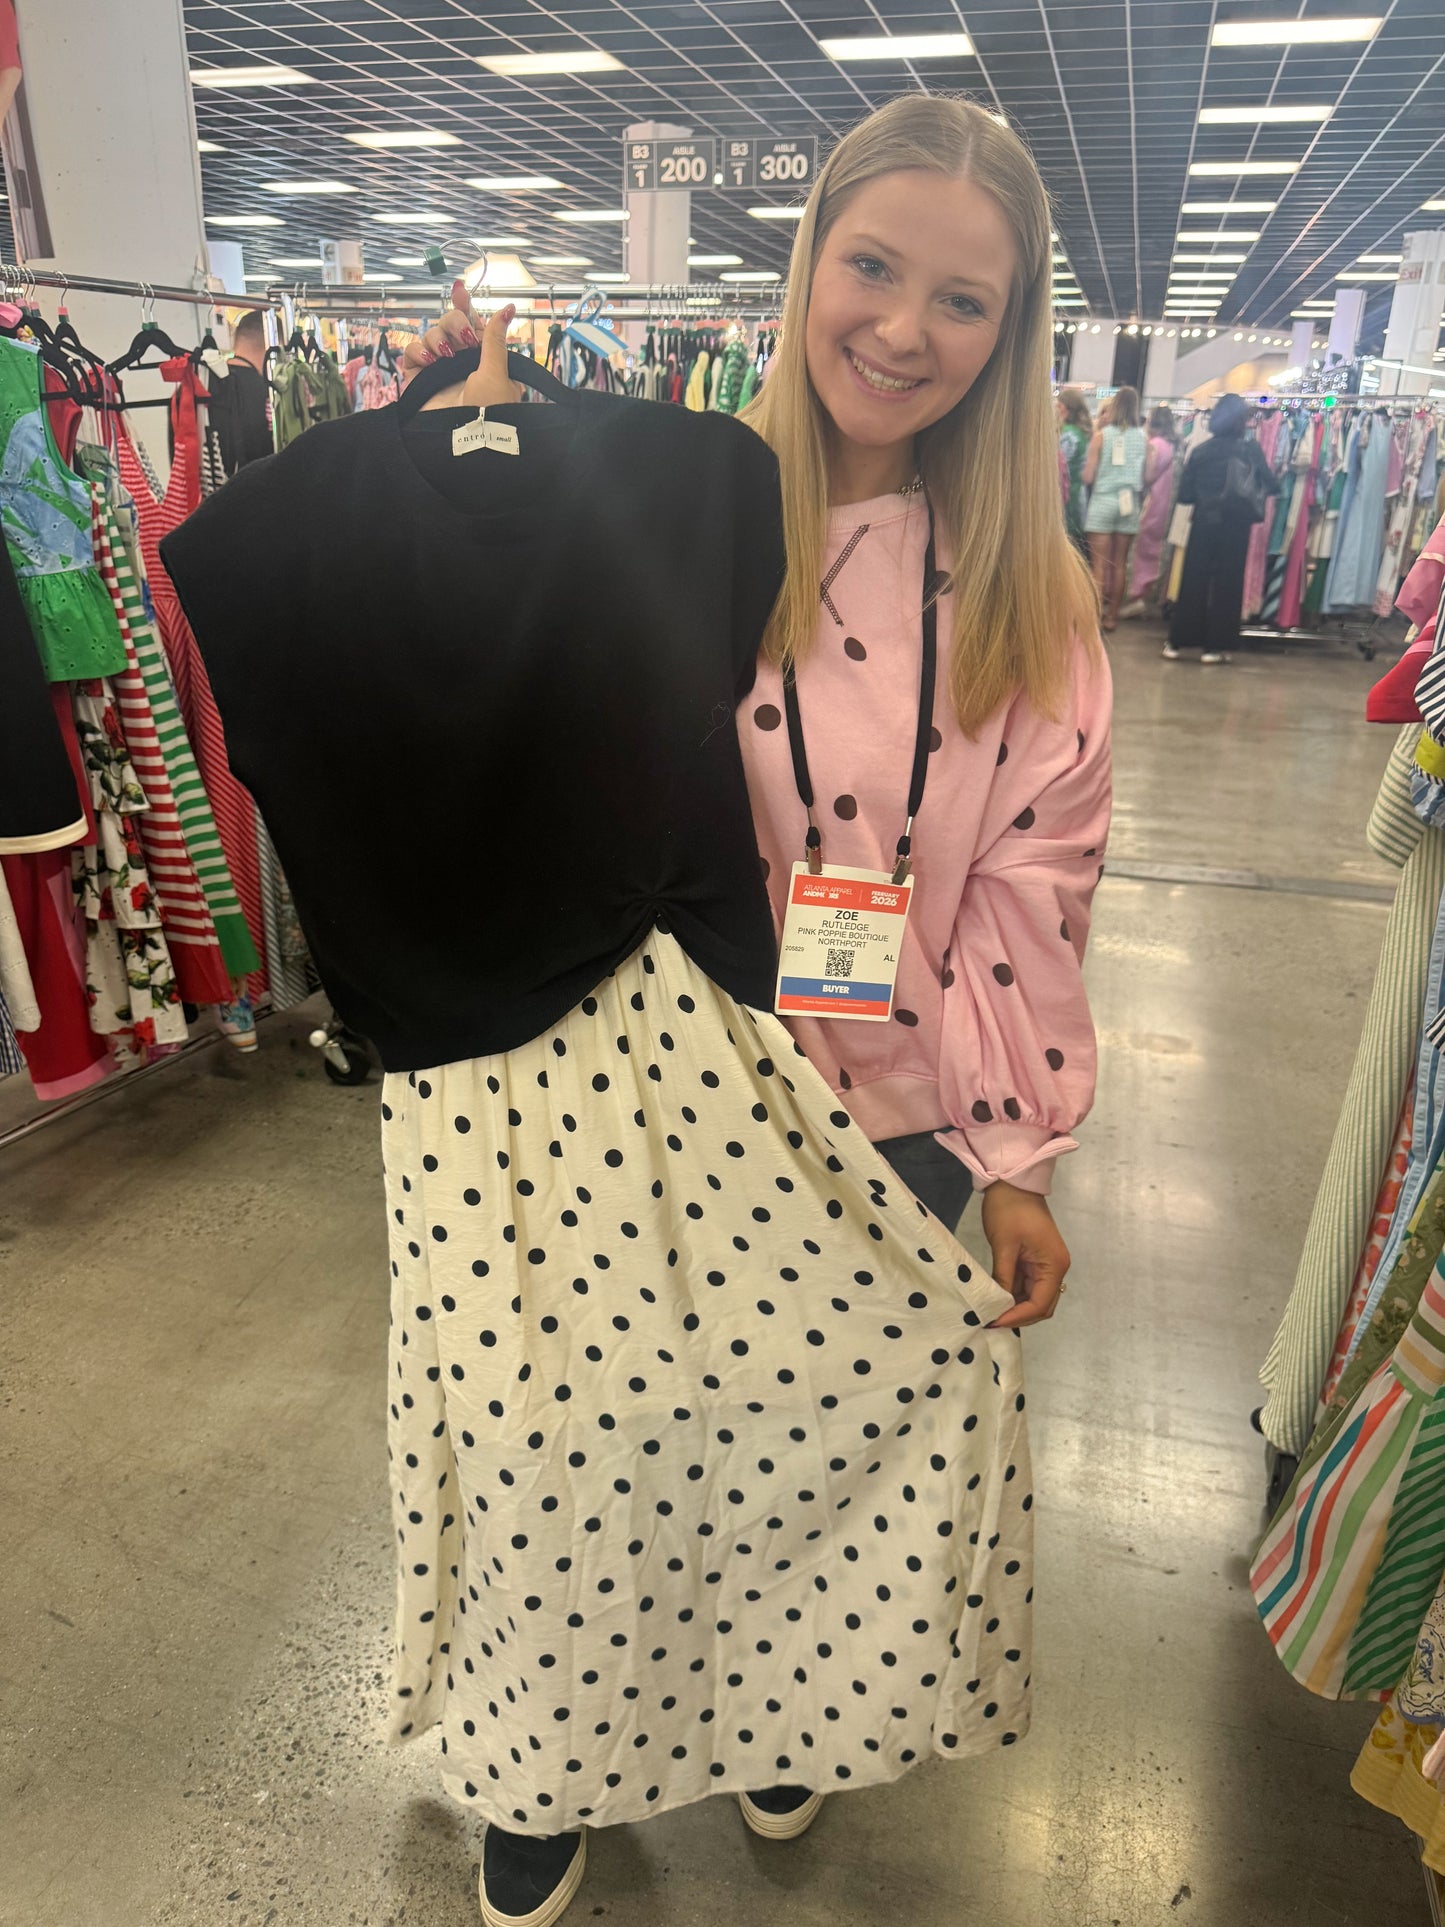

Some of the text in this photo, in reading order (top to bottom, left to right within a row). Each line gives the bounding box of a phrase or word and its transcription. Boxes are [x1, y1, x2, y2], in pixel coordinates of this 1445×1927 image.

[632, 145, 650, 159] B3
[730, 143, 749, 157] B3
[660, 157, 708, 183] 200
[760, 154, 809, 181] 300
[635, 170, 645, 188] 1
[733, 167, 743, 186] 1
[804, 884, 854, 896] ATLANTA APPAREL
[871, 897, 897, 906] 2026
[835, 910, 859, 921] ZOE
[822, 920, 870, 932] RUTLEDGE
[797, 927, 889, 942] PINK POPPIE BOUTIQUE
[818, 938, 868, 949] NORTHPORT
[883, 954, 895, 962] AL
[822, 984, 850, 994] BUYER
